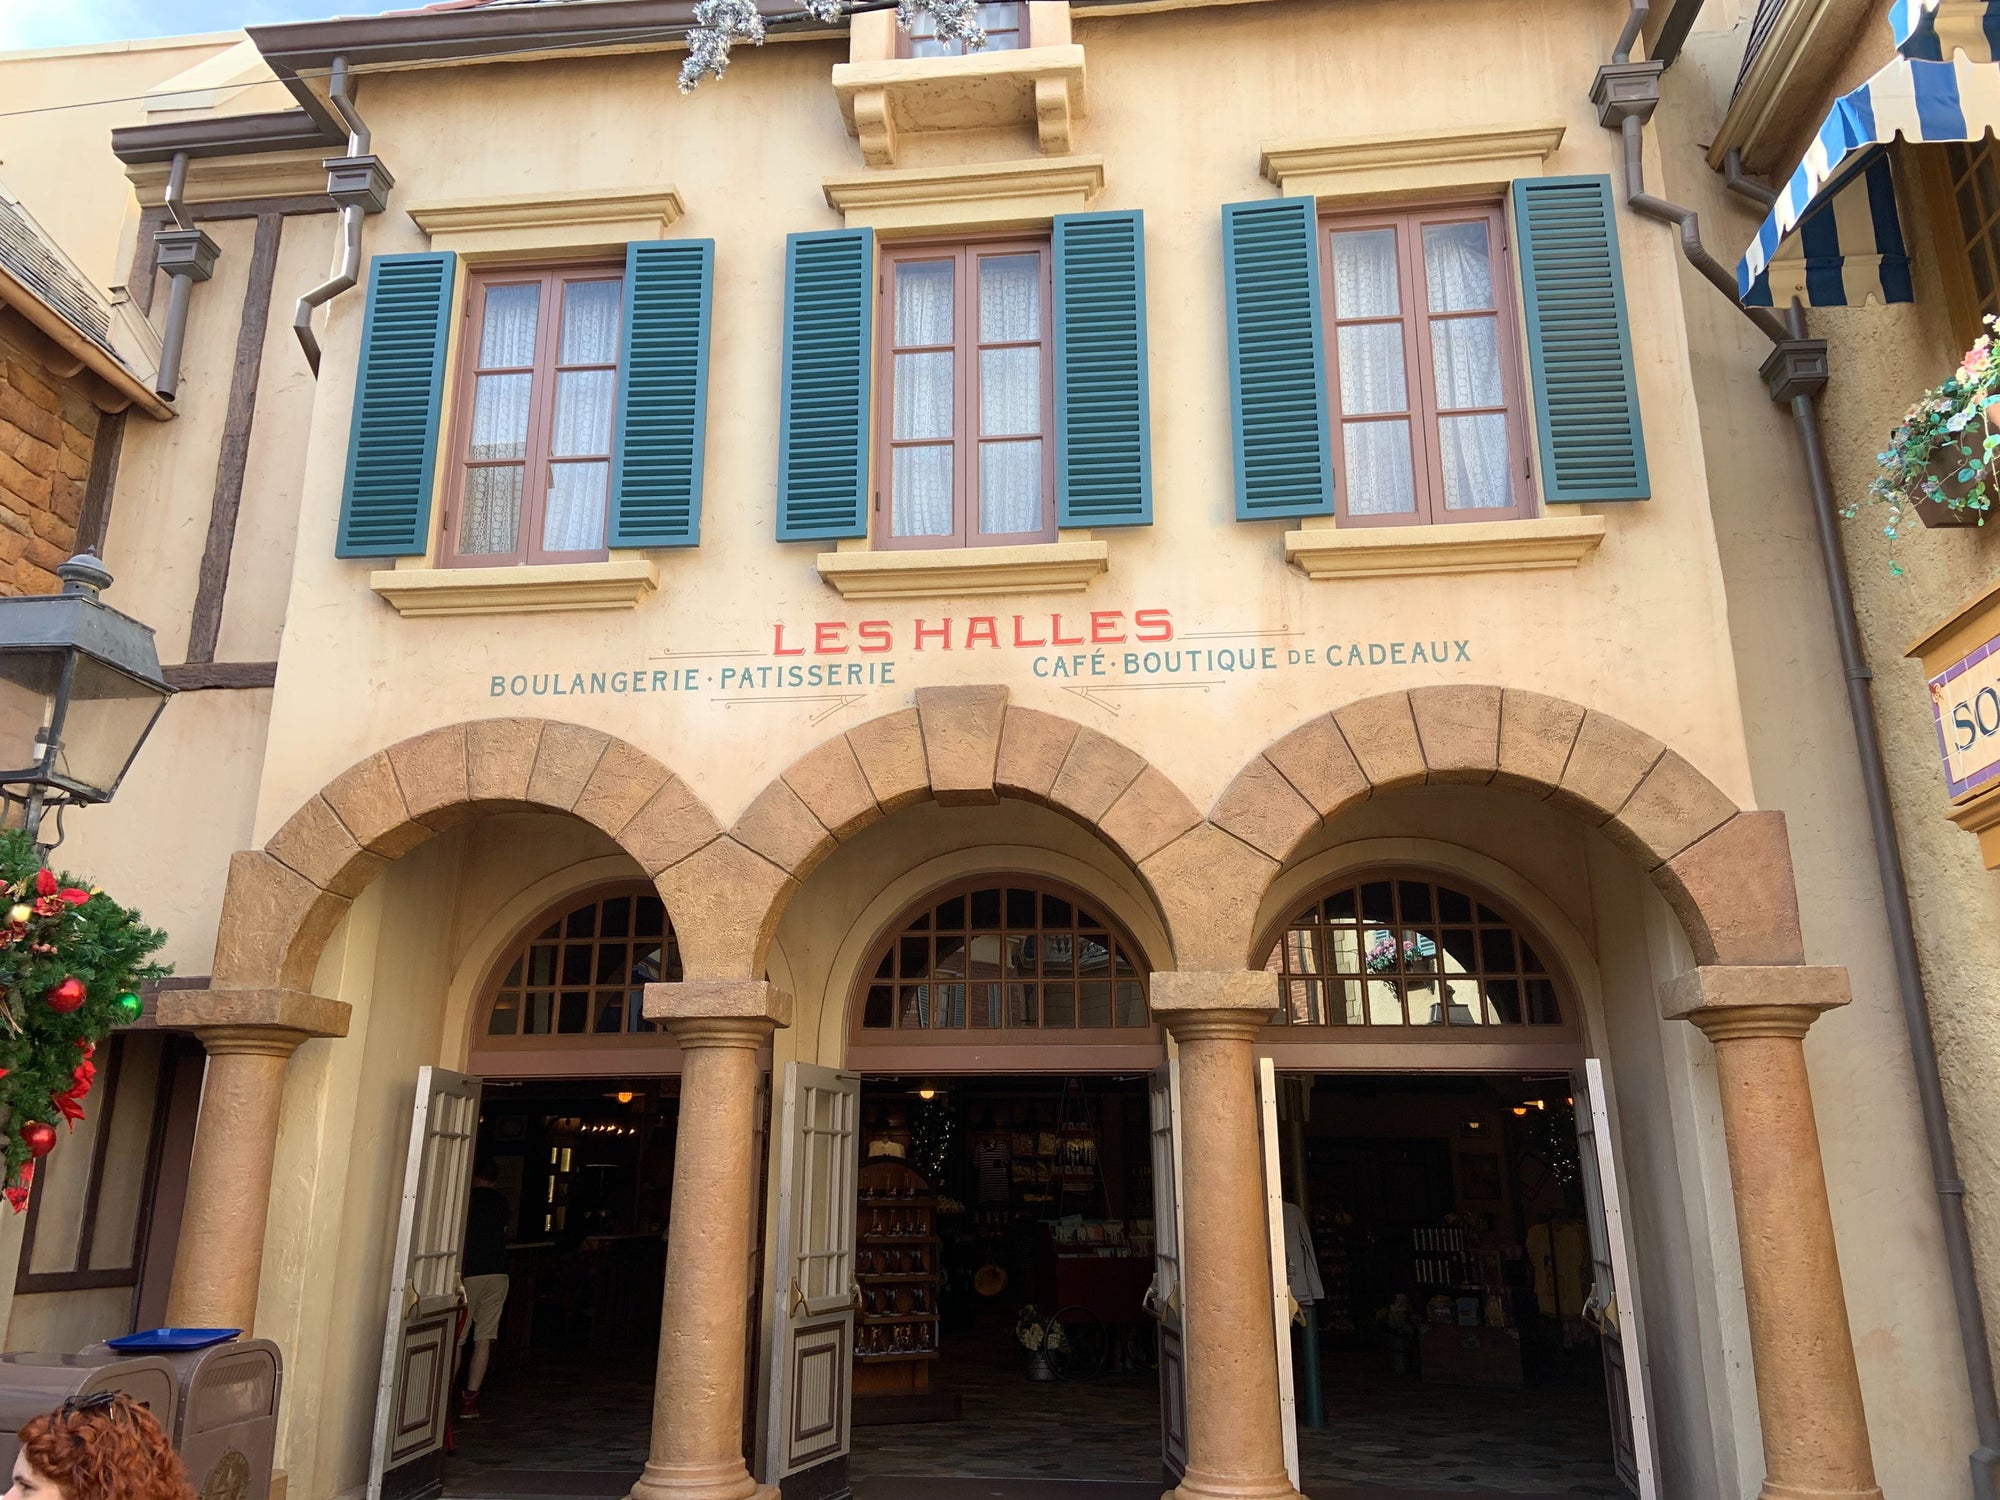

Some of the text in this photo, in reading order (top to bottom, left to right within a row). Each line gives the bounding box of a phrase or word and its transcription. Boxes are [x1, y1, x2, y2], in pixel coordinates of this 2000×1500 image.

[773, 608, 1174, 657] LES HALLES
[490, 661, 896, 697] BOULANGERIE PATISSERIE
[1032, 639, 1472, 679] CAFÉ BOUTIQUE DE CADEAUX
[1952, 678, 2000, 754] SO
